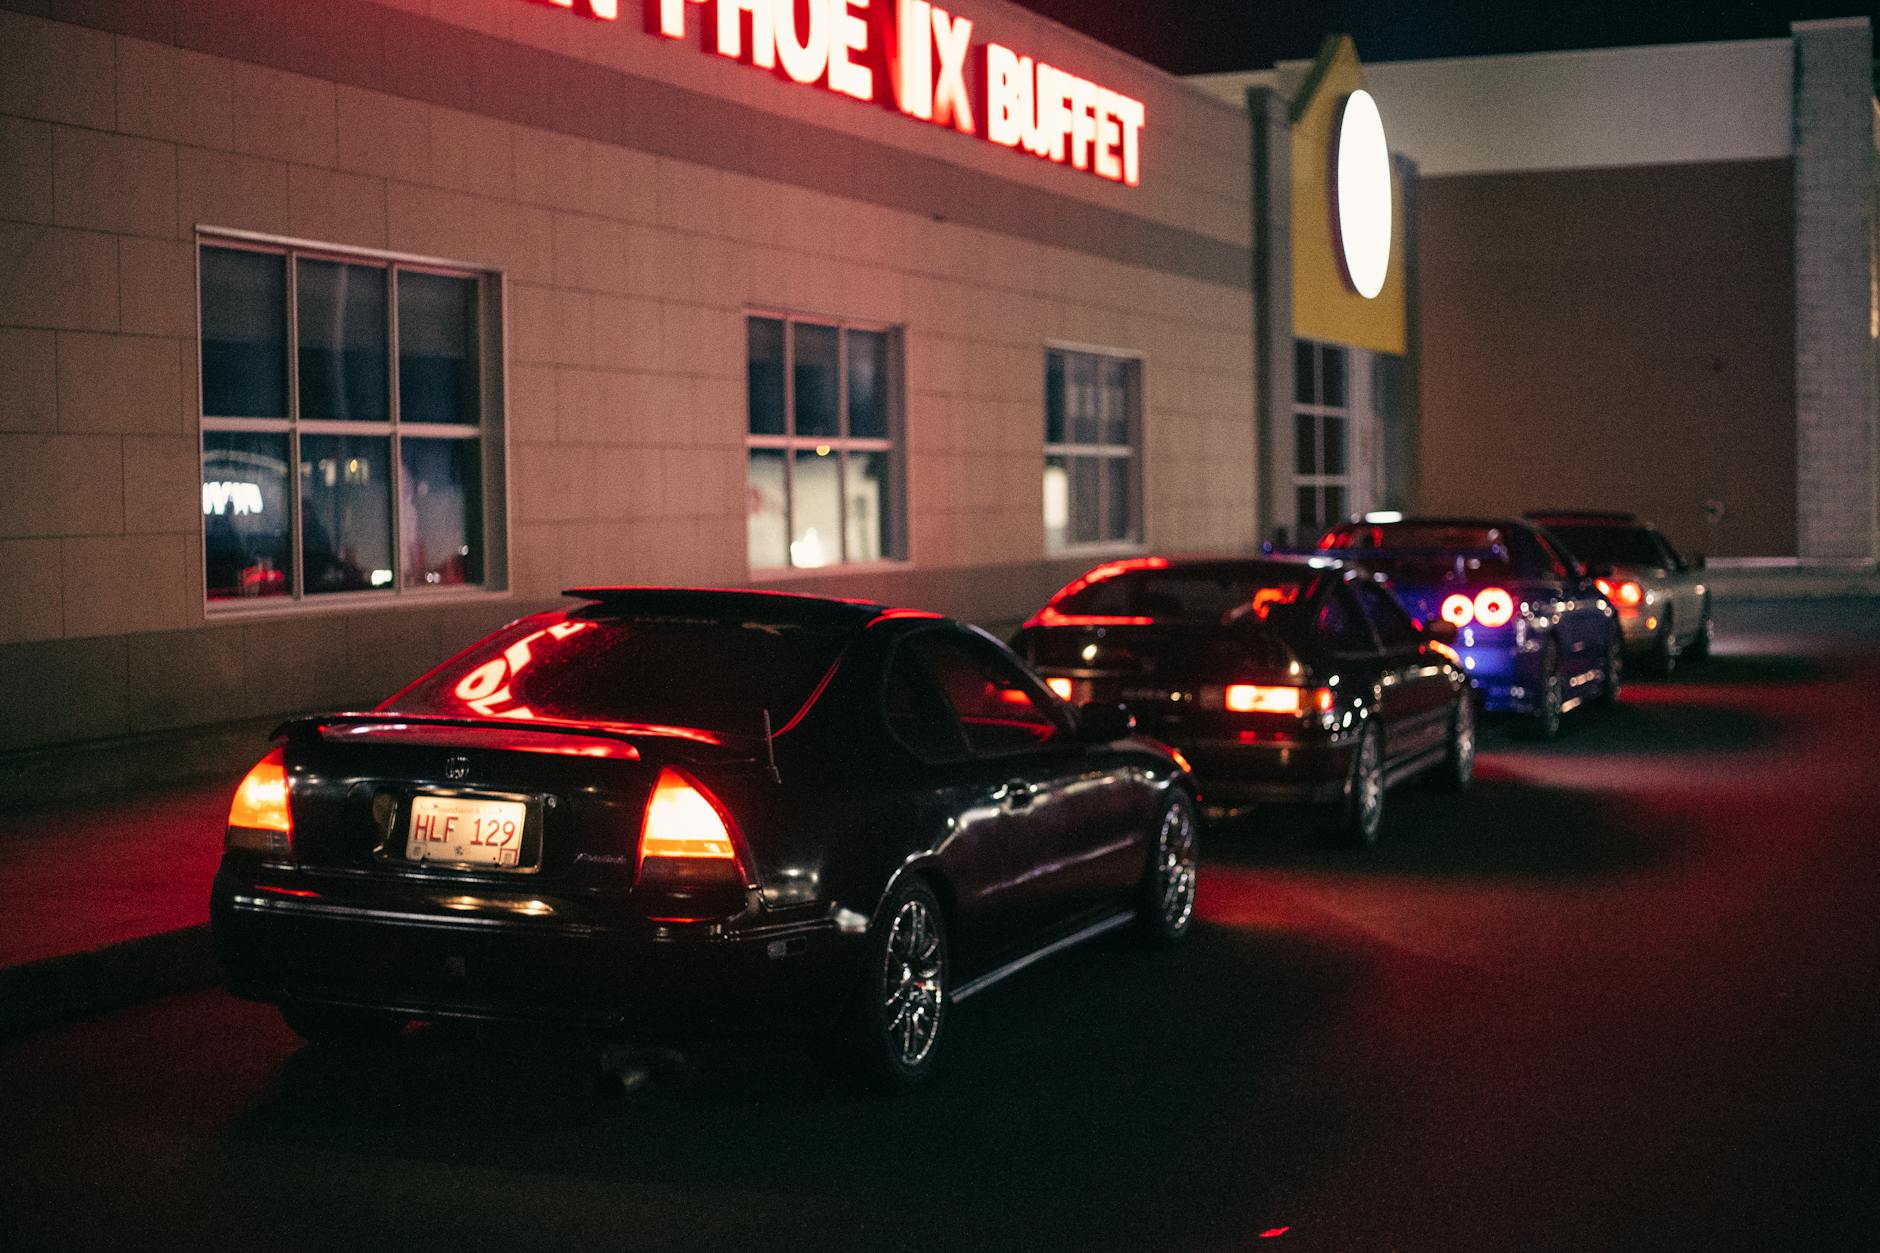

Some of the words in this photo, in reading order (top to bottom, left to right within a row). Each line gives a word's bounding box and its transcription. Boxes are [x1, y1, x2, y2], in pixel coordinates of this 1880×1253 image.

[985, 43, 1145, 187] BUFFET
[414, 813, 460, 844] HLF
[469, 817, 517, 847] 129
